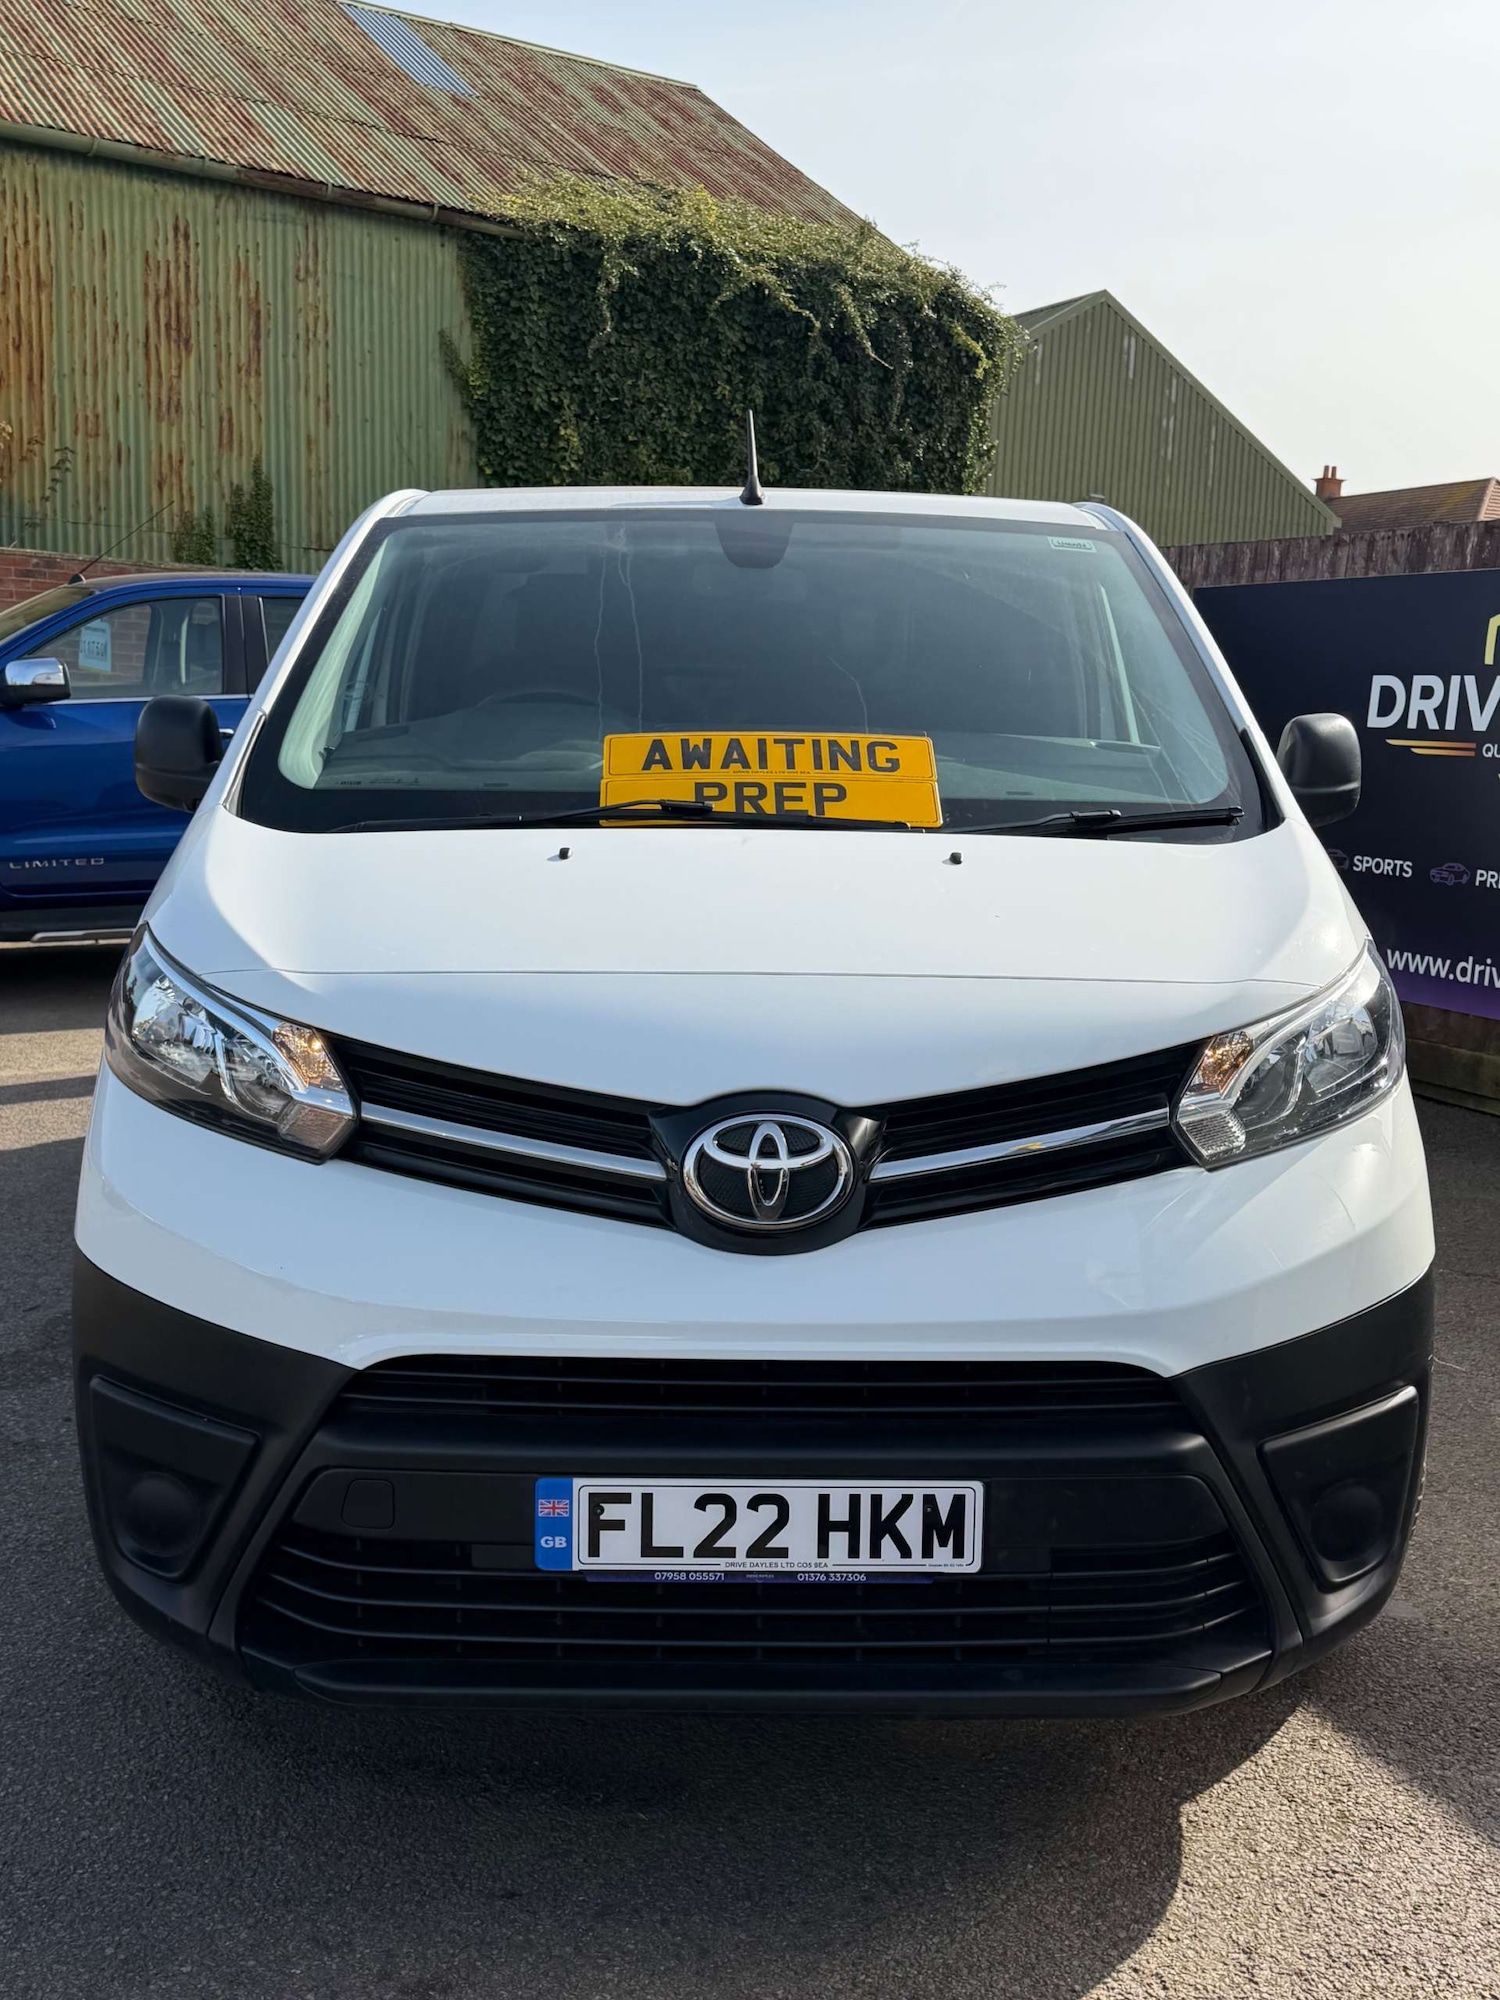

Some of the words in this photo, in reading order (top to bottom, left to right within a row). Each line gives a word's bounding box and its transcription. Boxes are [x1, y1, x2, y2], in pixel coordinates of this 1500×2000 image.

[1367, 674, 1500, 732] DRIV
[641, 738, 901, 773] AWAITING
[695, 782, 847, 816] PREP
[9, 857, 104, 870] LIMITED
[1352, 855, 1413, 878] SPORTS
[1387, 948, 1500, 989] www.driv
[588, 1492, 790, 1559] FL22
[817, 1493, 966, 1559] HKM
[540, 1536, 567, 1548] GB
[654, 1572, 686, 1581] 07958
[688, 1572, 724, 1581] 055571
[797, 1573, 827, 1582] 01376
[828, 1573, 867, 1582] 337306
